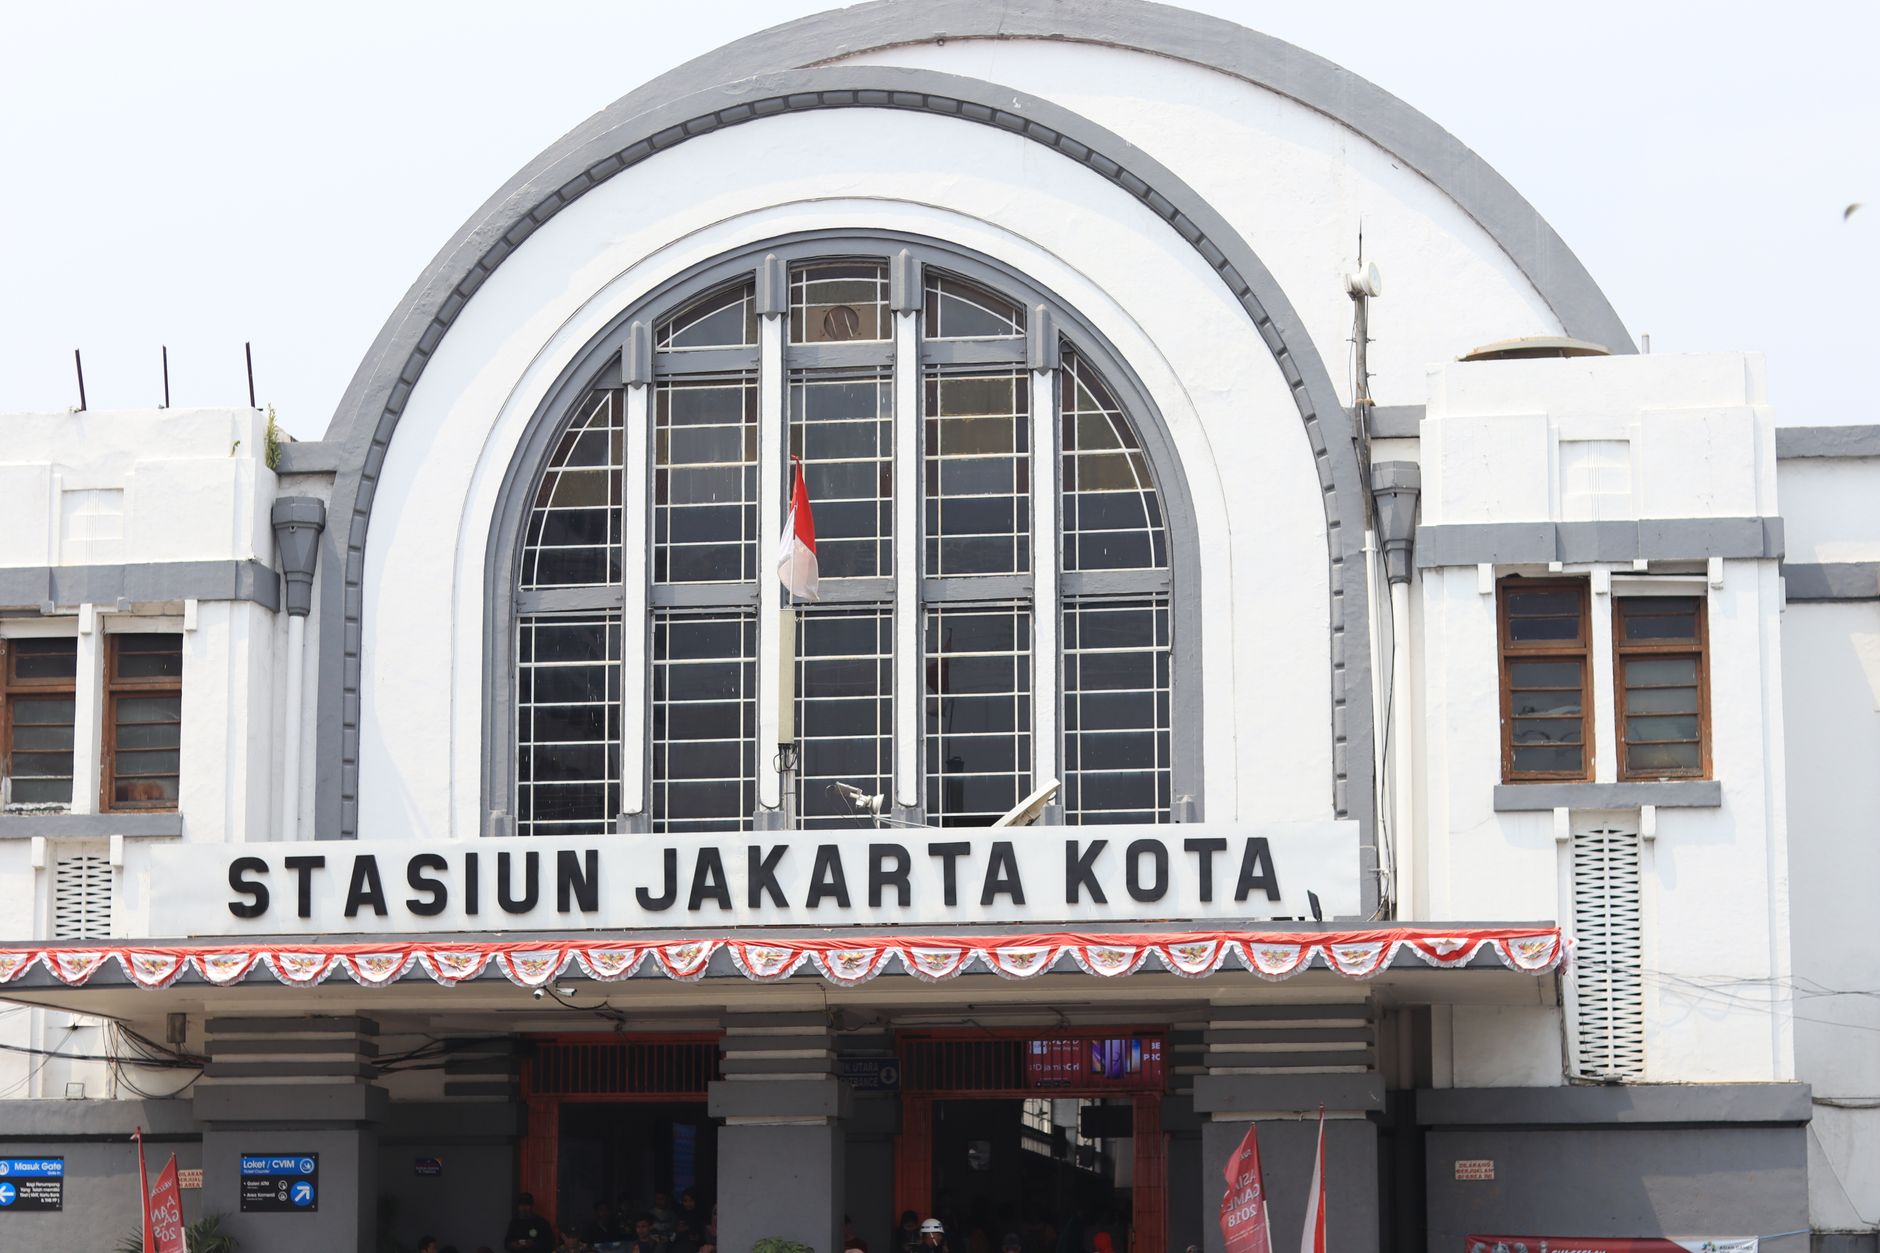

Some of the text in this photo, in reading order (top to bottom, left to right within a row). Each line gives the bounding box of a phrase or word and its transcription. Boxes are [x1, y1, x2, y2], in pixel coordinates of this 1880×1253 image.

[228, 837, 1282, 919] STASIUN JAKARTA KOTA
[14, 1162, 62, 1171] Masuk Gate
[243, 1159, 266, 1169] Loket
[272, 1159, 295, 1169] CVIM
